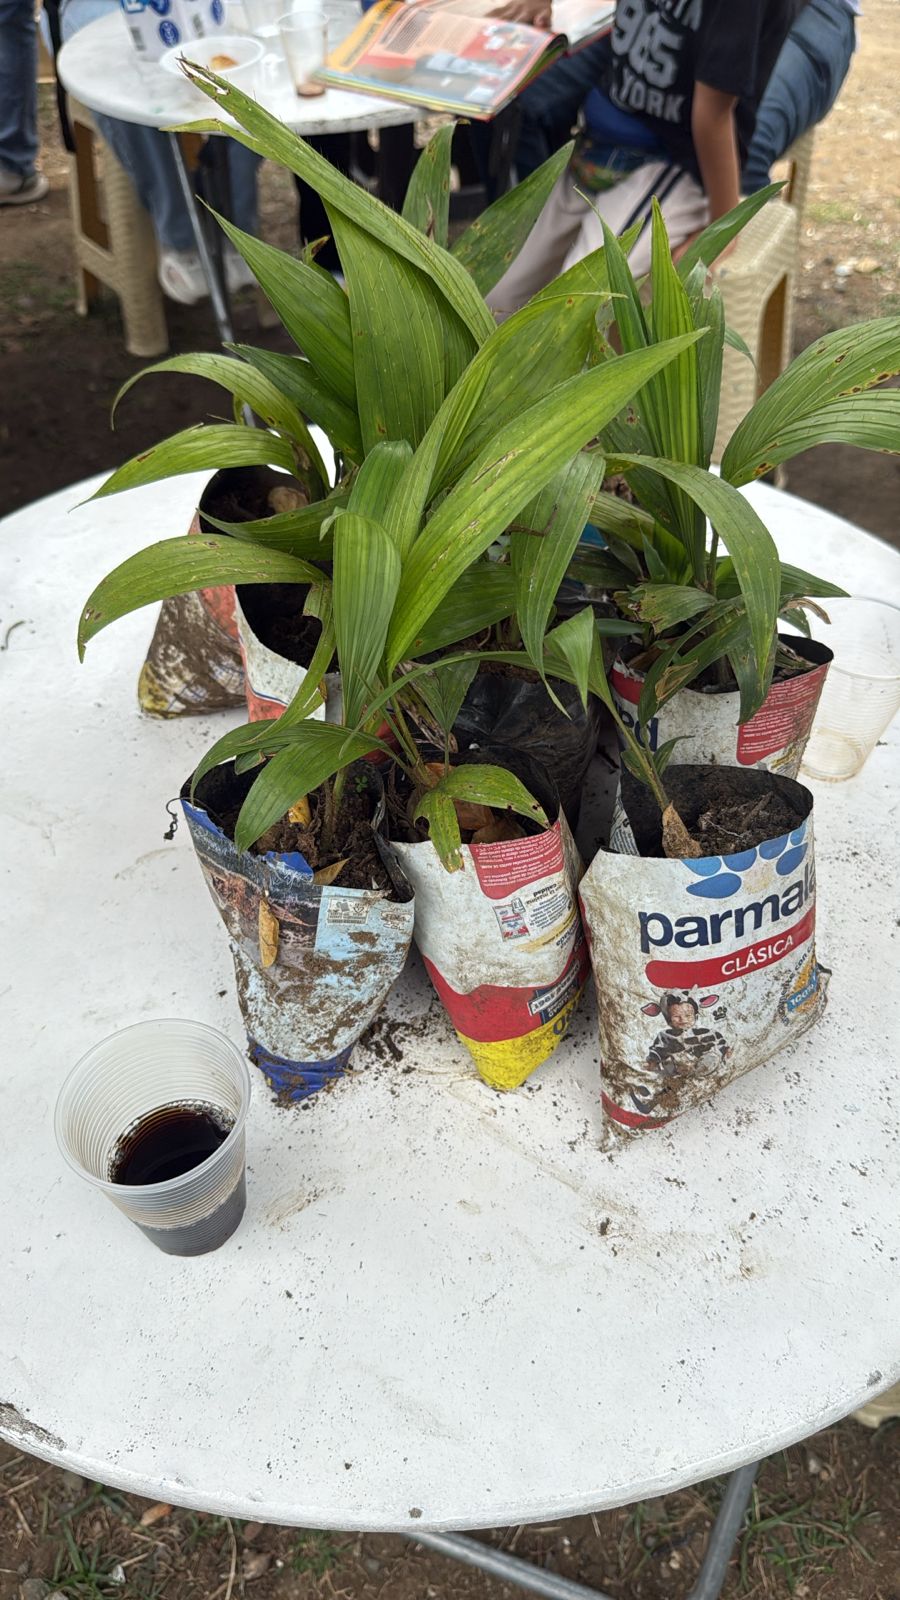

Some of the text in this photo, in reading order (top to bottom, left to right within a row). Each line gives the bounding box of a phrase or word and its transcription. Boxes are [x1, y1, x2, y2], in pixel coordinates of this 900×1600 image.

[620, 66, 687, 124] YORK
[532, 883, 557, 898] calidad
[721, 935, 794, 976] CLÁSICA
